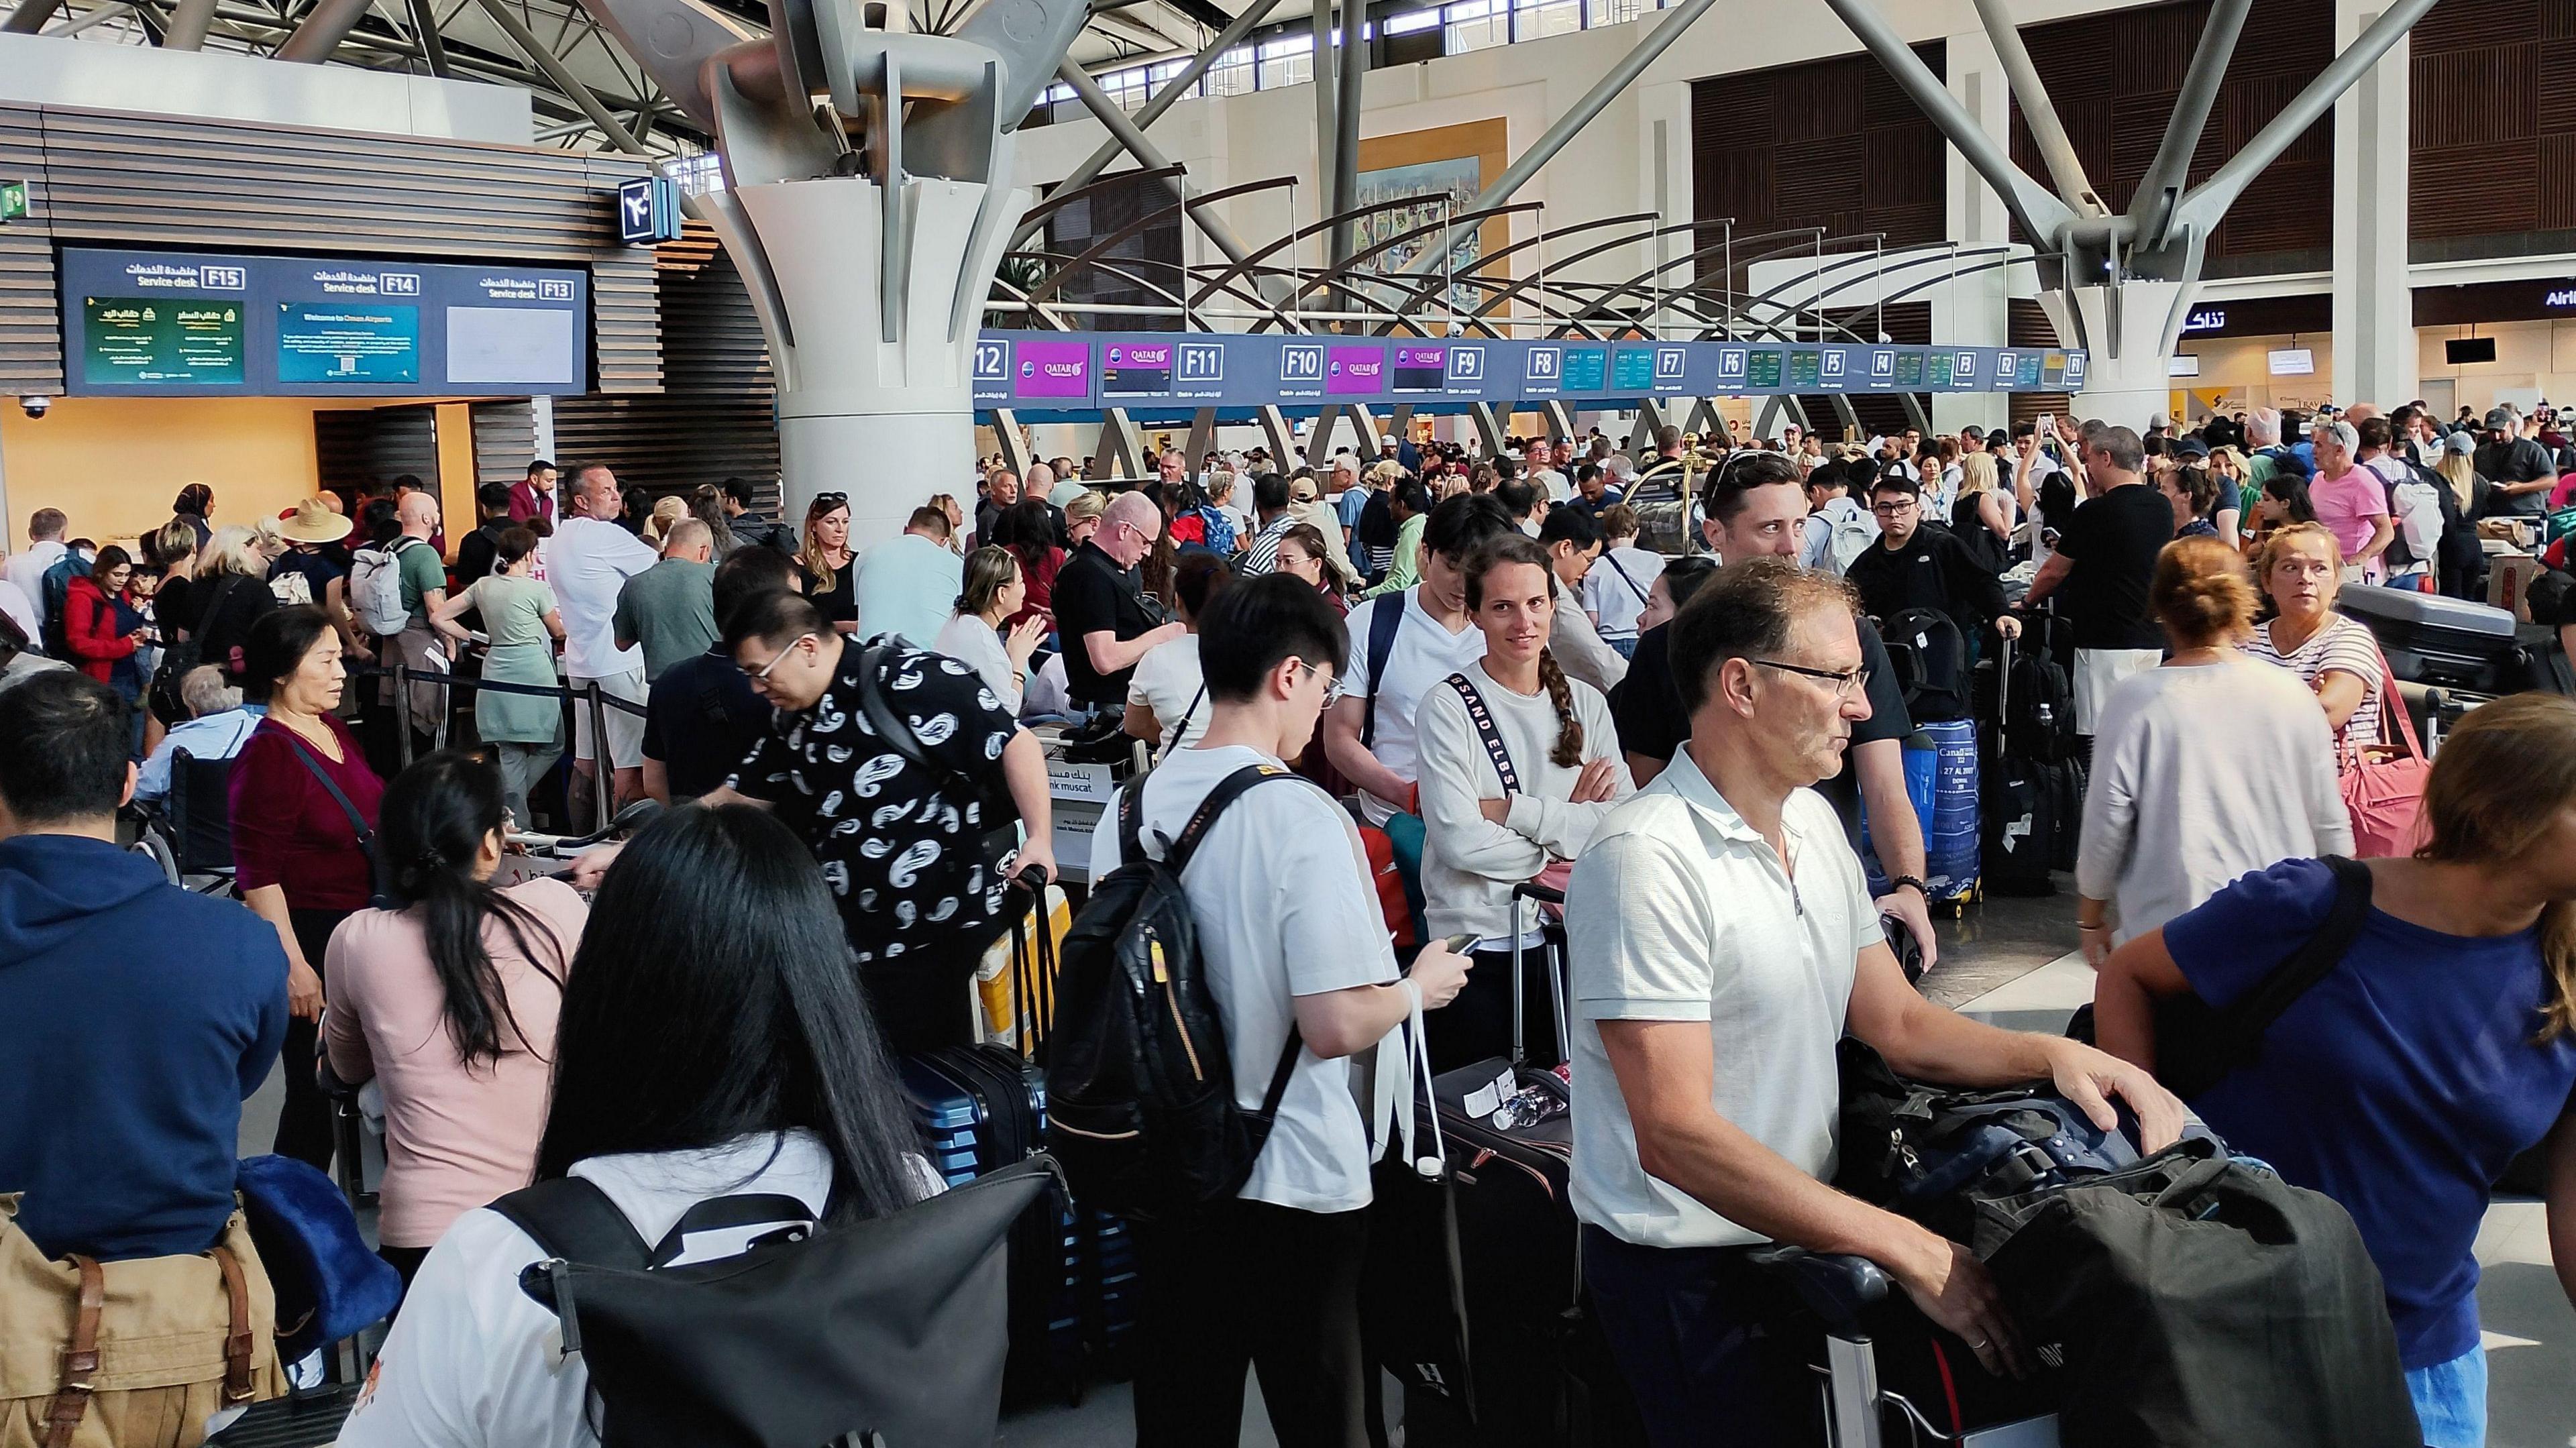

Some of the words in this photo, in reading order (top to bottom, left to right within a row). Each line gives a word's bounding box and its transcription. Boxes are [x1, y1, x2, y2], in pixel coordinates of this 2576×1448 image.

[126, 264, 163, 274] الخدمات
[313, 271, 346, 280] الخدمات
[138, 276, 172, 287] Service
[174, 277, 199, 288] desk
[209, 271, 239, 286] F15
[386, 278, 415, 292] F14
[323, 282, 355, 293] Service
[356, 284, 377, 294] desk
[488, 289, 516, 298] Service
[517, 290, 536, 299] desk
[545, 284, 568, 297] F13
[976, 347, 1000, 374] 12
[1131, 350, 1156, 361] QATAR
[1186, 349, 1216, 374] F11
[1287, 351, 1317, 374] F10
[1415, 352, 1434, 361] QATAR
[1725, 353, 1739, 372] F6
[1044, 363, 1071, 374] QATAR
[1349, 364, 1371, 374] QATAR
[1458, 353, 1475, 374] F9
[1535, 353, 1552, 374] F8
[1663, 353, 1678, 373] F7
[1827, 354, 1839, 372] F5
[1877, 355, 1888, 372] F4
[2001, 357, 2012, 373] F2
[1071, 769, 1091, 783] بنك
[1049, 779, 1059, 789] nk
[1061, 783, 1092, 793] muscat
